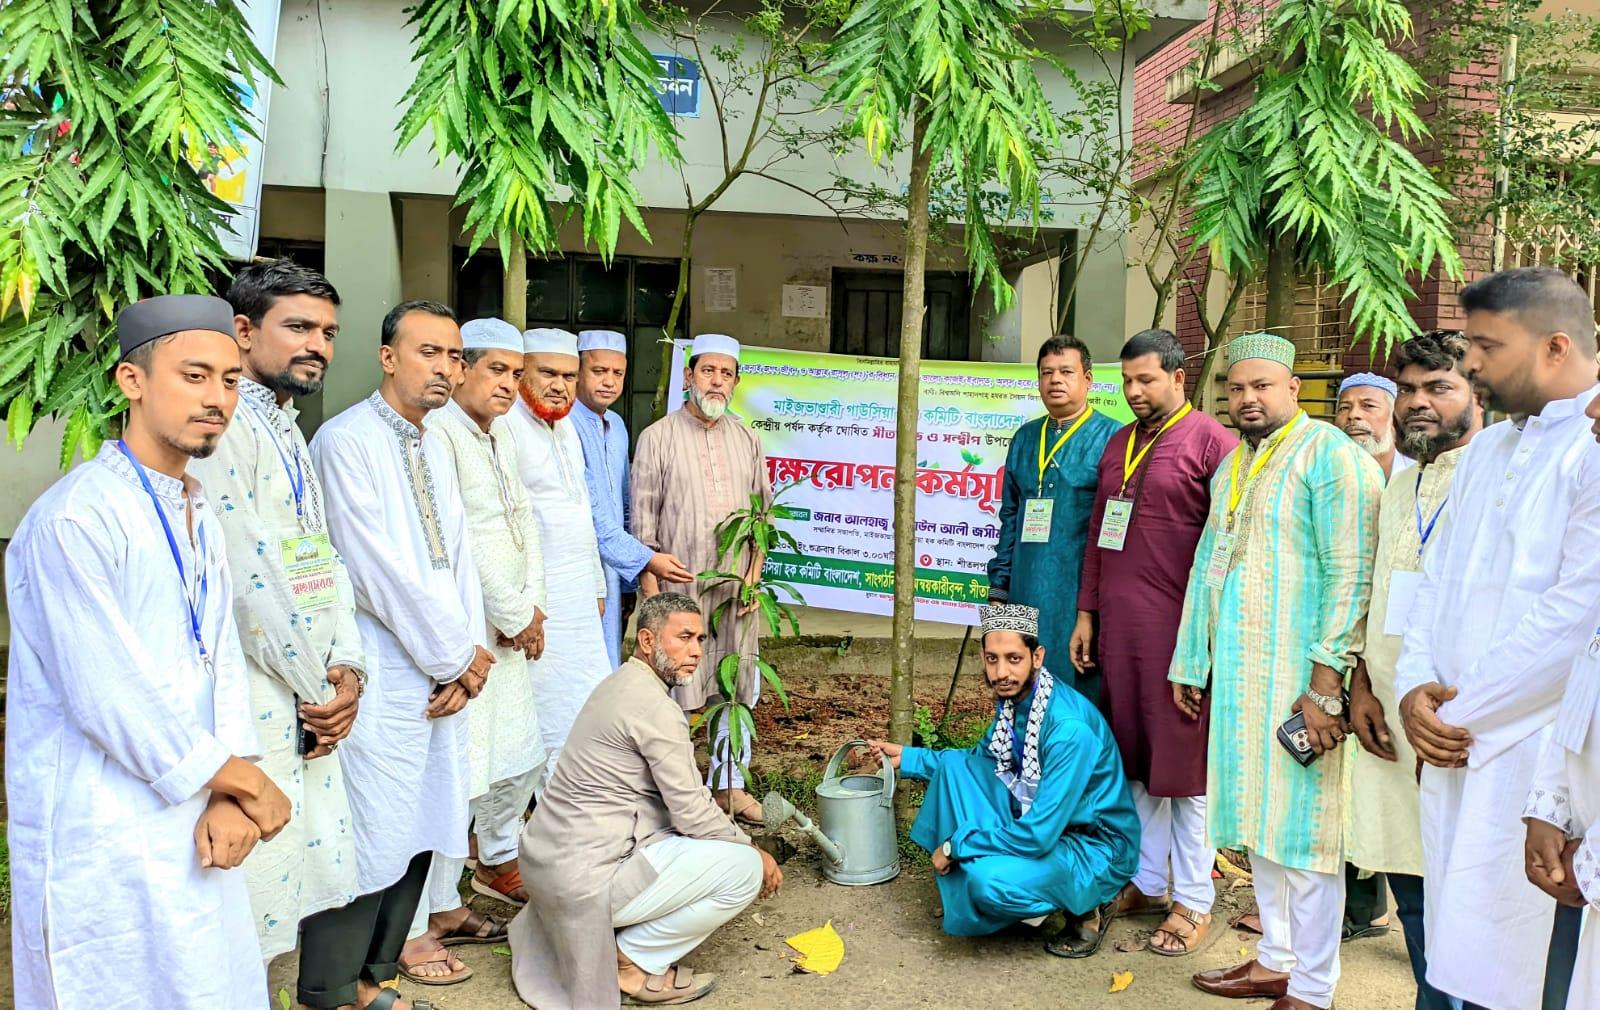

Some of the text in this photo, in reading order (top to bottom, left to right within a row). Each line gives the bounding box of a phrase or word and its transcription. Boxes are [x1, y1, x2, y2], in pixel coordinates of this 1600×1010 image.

[922, 406, 961, 423] কমিটি
[963, 411, 1026, 428] বাংলাদেশ
[927, 432, 938, 442] ও
[813, 511, 842, 523] জনাব
[940, 522, 969, 536] আলী
[784, 563, 797, 578] হক
[799, 561, 822, 580] কমিটি
